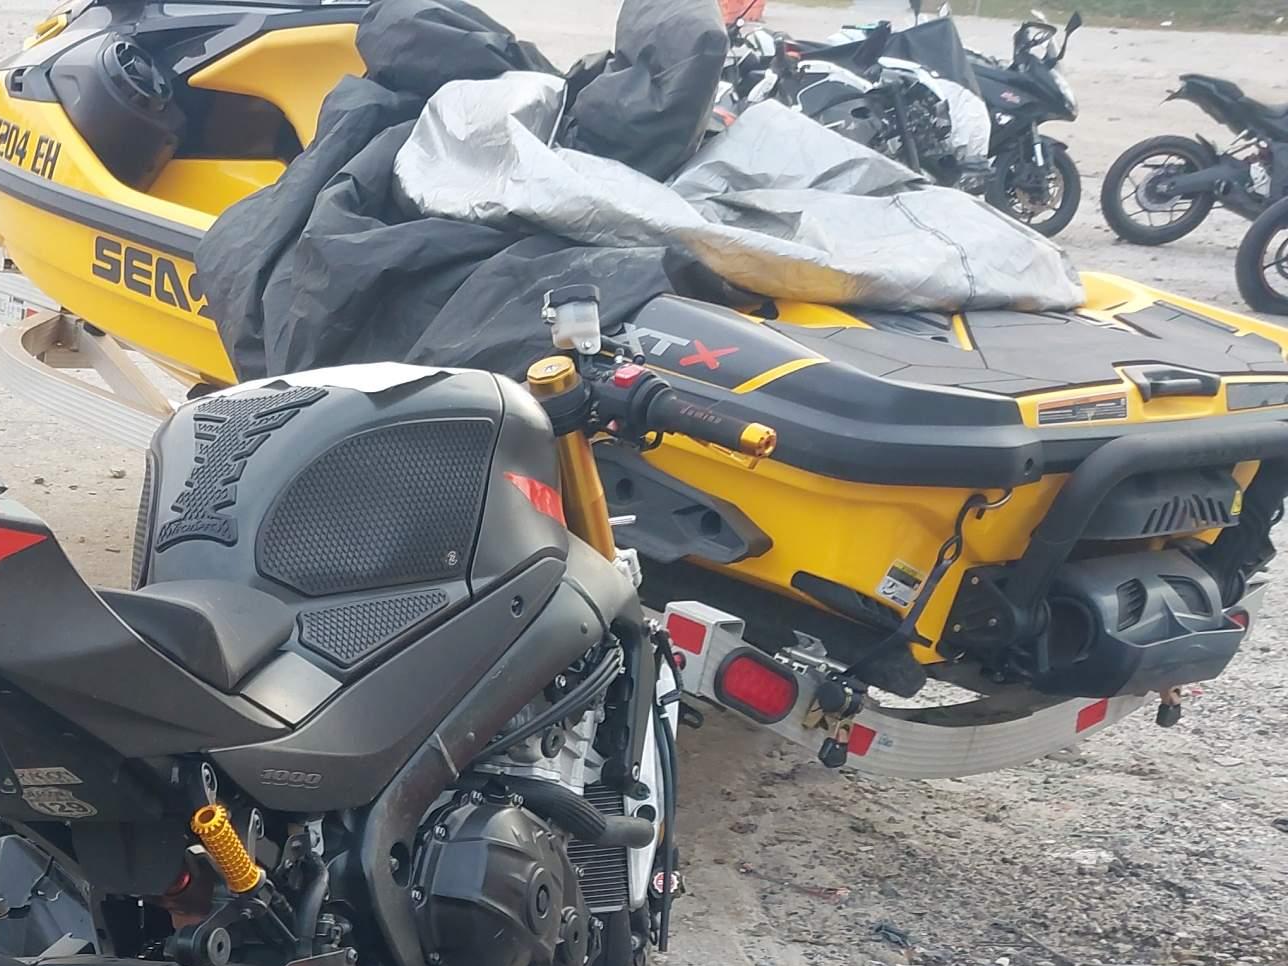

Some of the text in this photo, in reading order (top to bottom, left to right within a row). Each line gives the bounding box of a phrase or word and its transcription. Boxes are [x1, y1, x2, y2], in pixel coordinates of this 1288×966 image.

[30, 135, 62, 180] EH
[679, 339, 741, 370] X
[260, 767, 322, 789] 1000
[37, 801, 90, 814] 129
